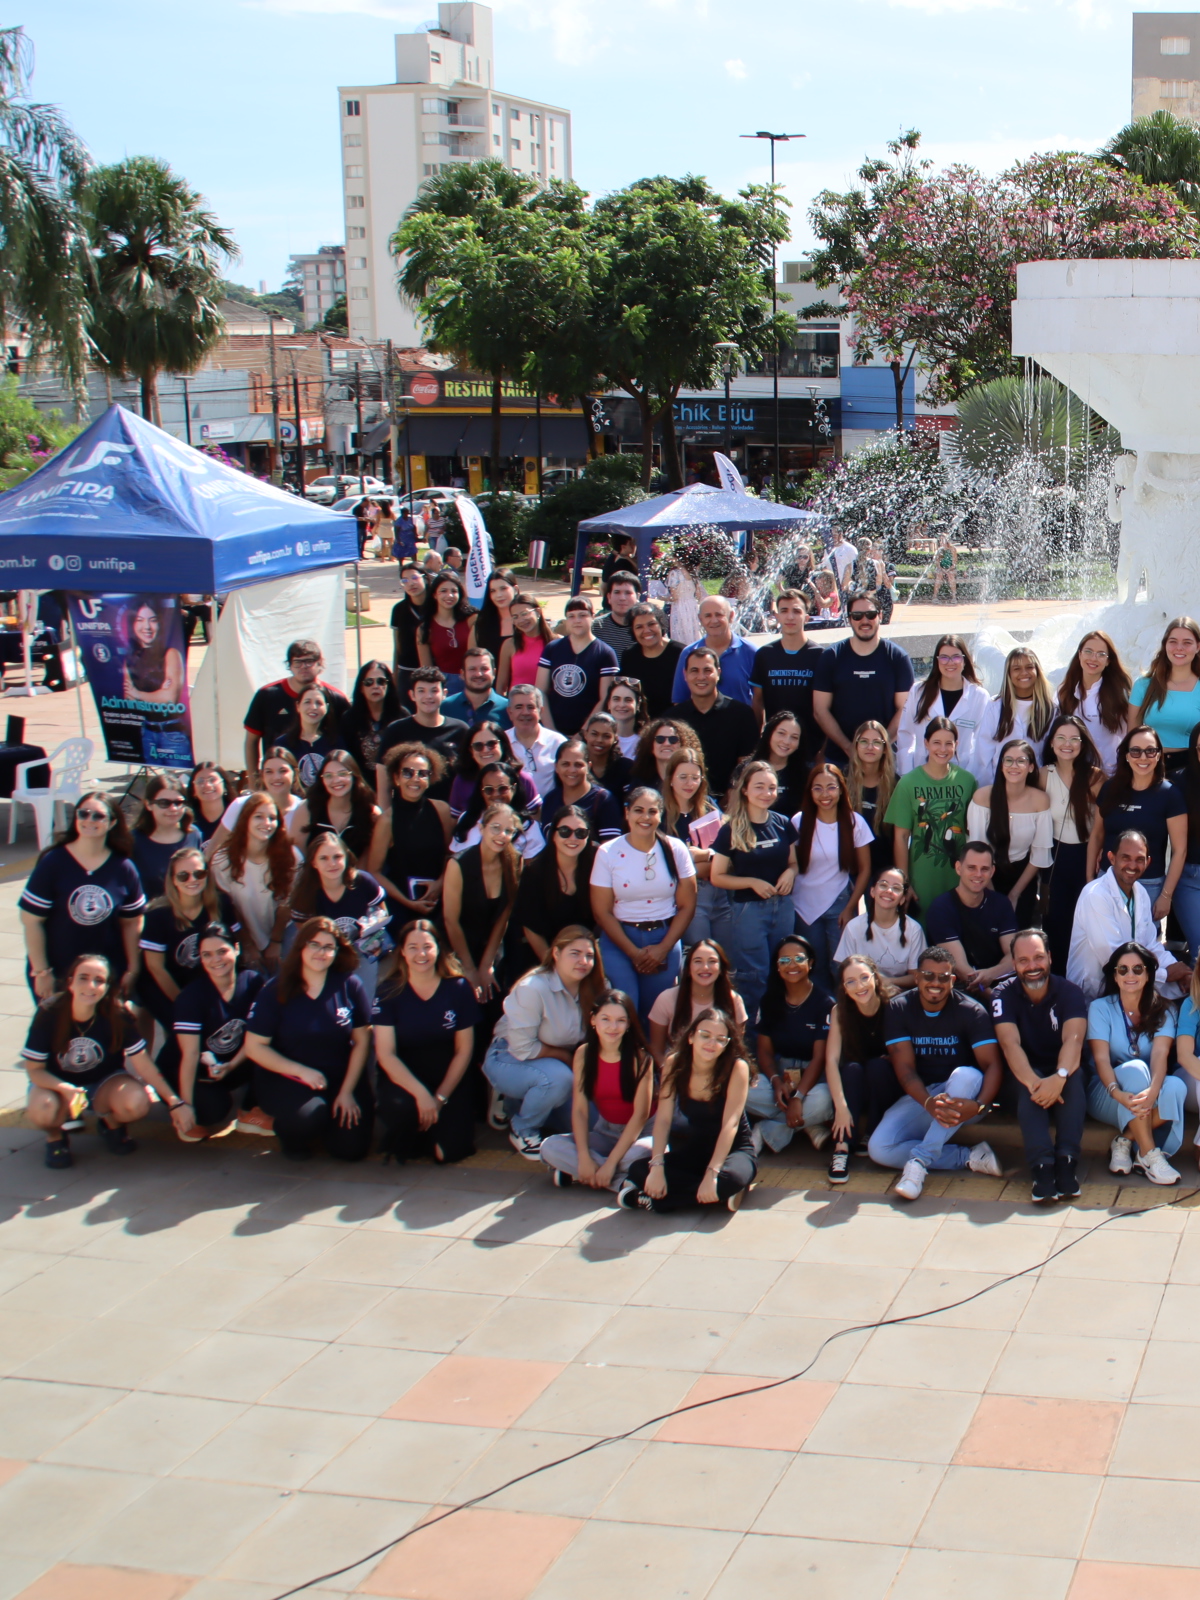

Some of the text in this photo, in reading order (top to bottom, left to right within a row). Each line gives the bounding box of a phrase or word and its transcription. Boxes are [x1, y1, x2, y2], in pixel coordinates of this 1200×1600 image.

[16, 481, 115, 507] UNIFIPA
[89, 558, 136, 573] unifipa
[77, 622, 112, 631] UNIFIPA
[768, 669, 814, 678] ADMINISTRAÇÃO
[101, 695, 186, 717] Administração
[914, 786, 945, 799] FARM
[991, 998, 1003, 1018] 3
